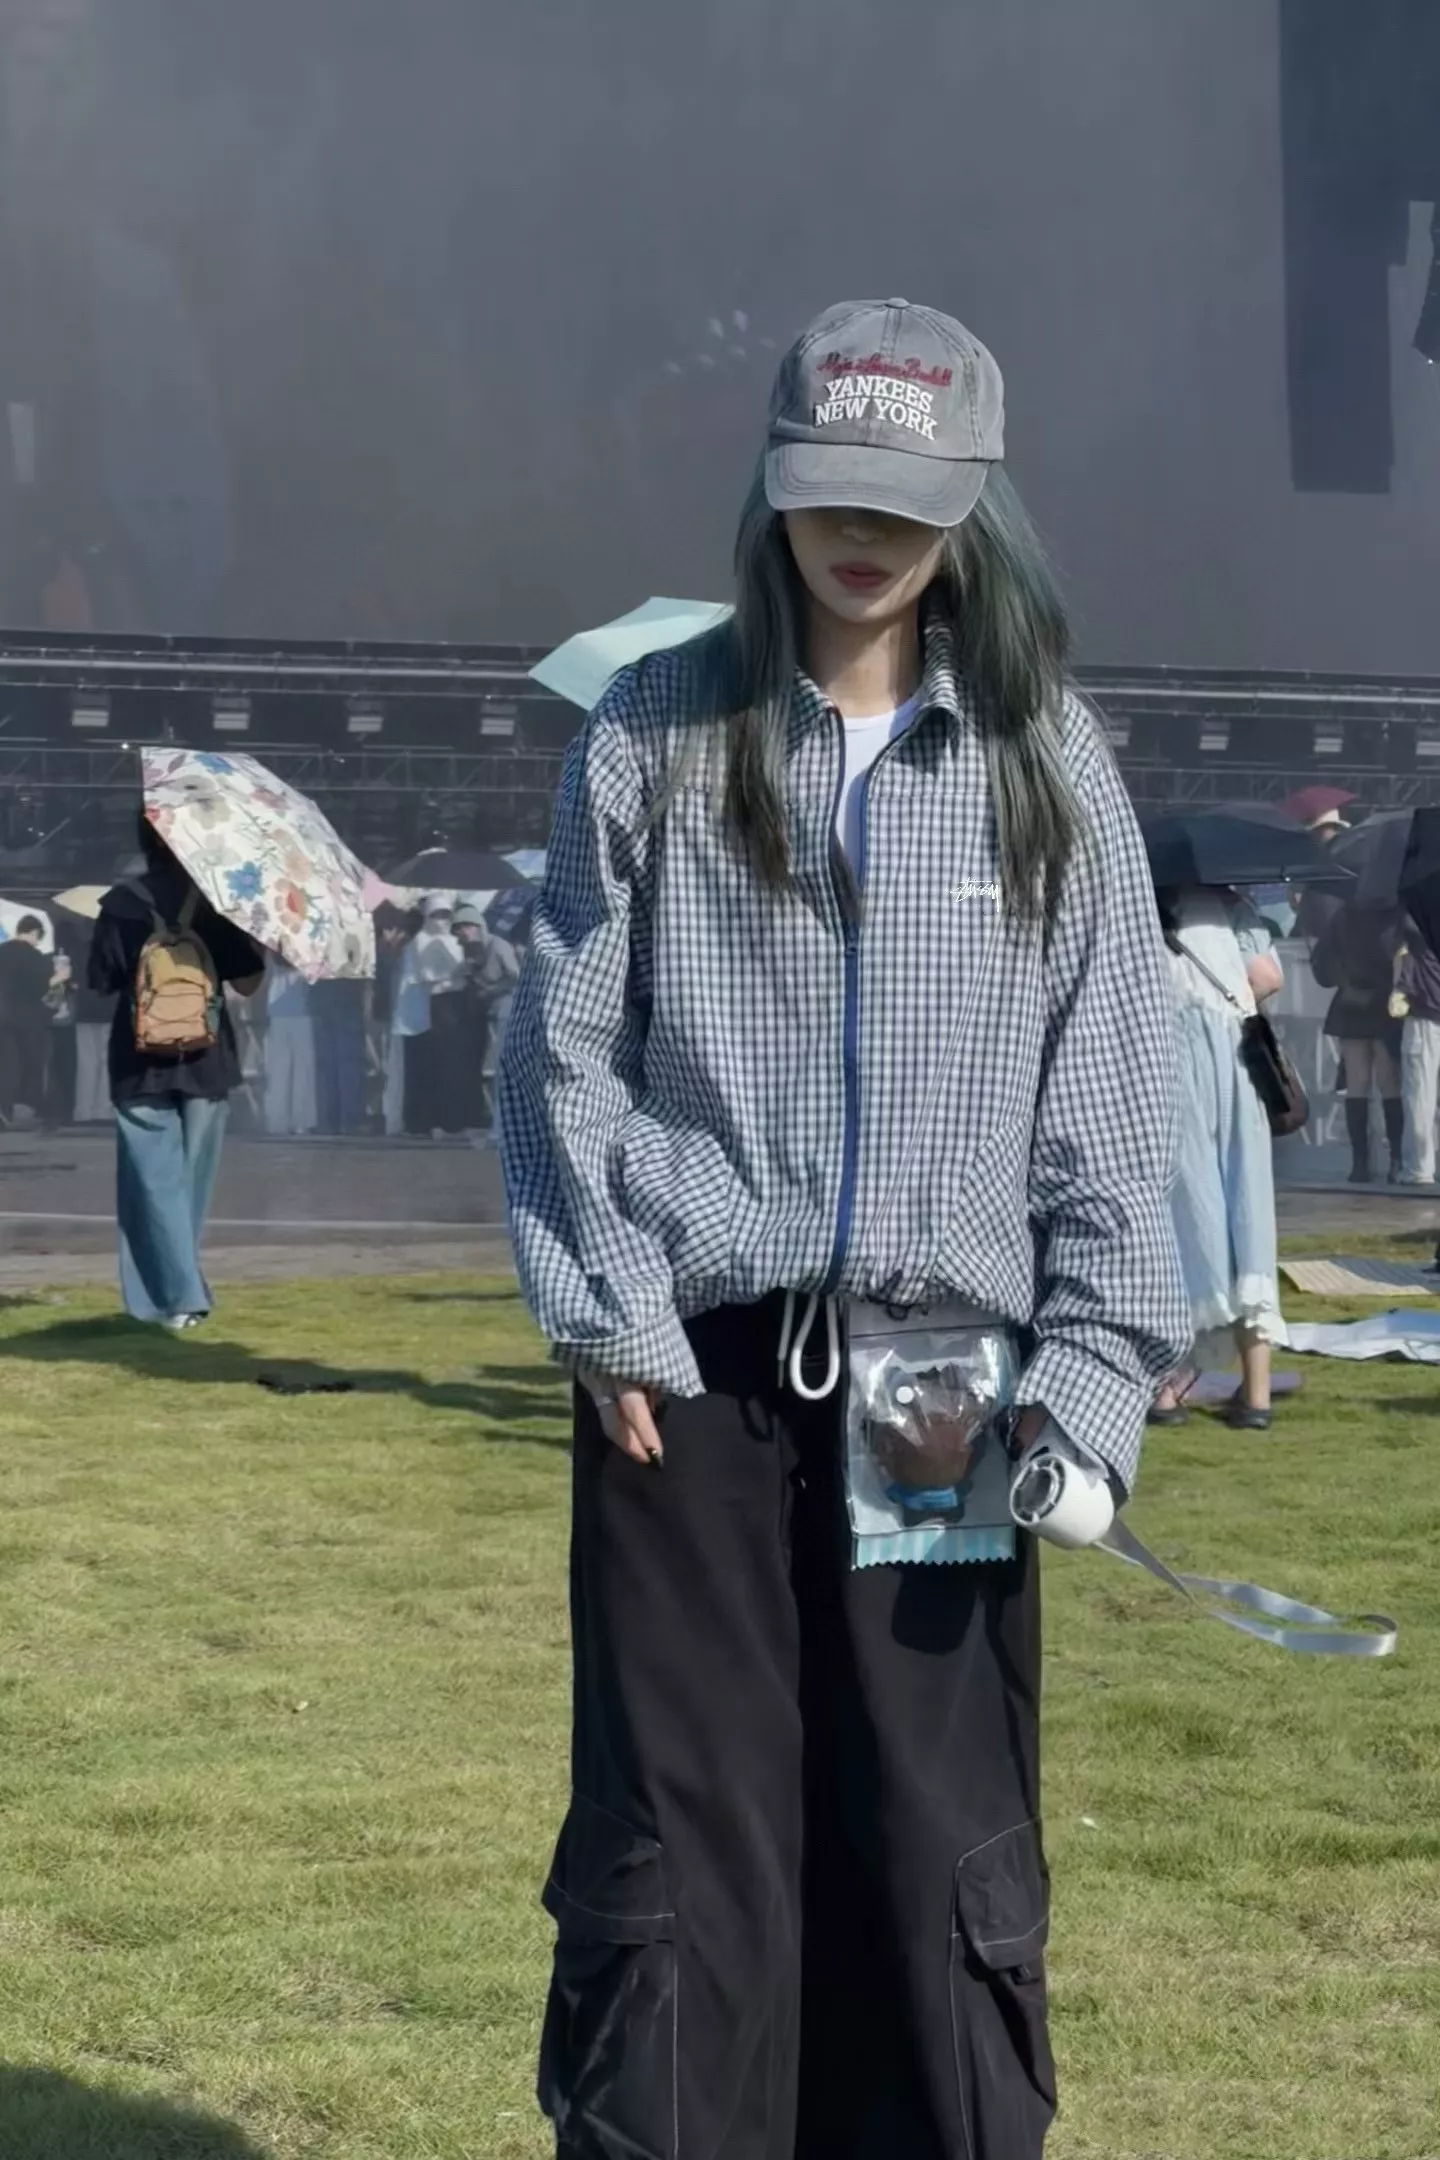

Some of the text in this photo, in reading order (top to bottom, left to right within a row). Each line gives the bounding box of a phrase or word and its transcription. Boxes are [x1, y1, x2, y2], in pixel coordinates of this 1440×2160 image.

[824, 375, 934, 413] YANKEES
[815, 398, 938, 440] NEW YORK
